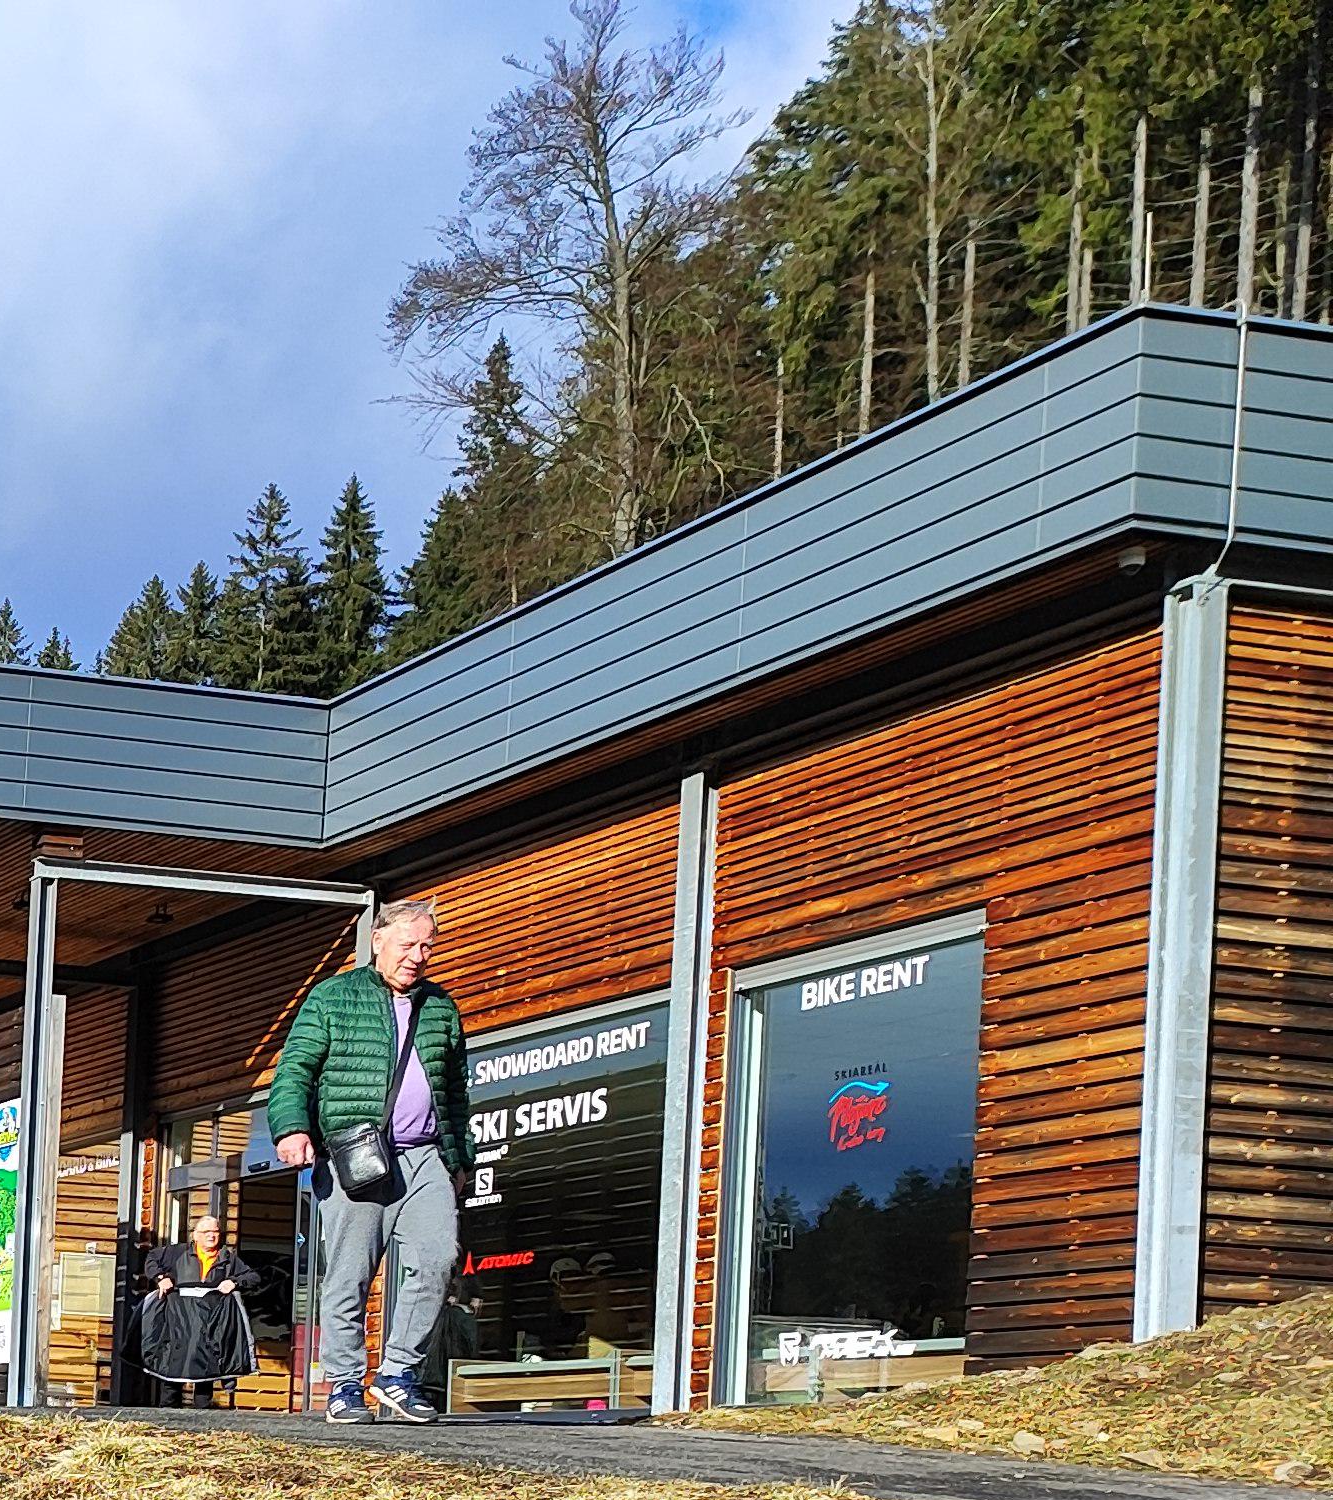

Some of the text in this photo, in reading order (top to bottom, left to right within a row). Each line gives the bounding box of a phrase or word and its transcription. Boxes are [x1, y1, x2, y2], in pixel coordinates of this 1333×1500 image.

[801, 955, 930, 1011] BIKE RENT
[475, 1036, 593, 1085] SNOWBOARD
[597, 1021, 651, 1058] RENT
[834, 1062, 888, 1081] SKIAREAL
[469, 1088, 608, 1144] SKI SERVIS
[477, 1251, 535, 1270] ATOMIC
